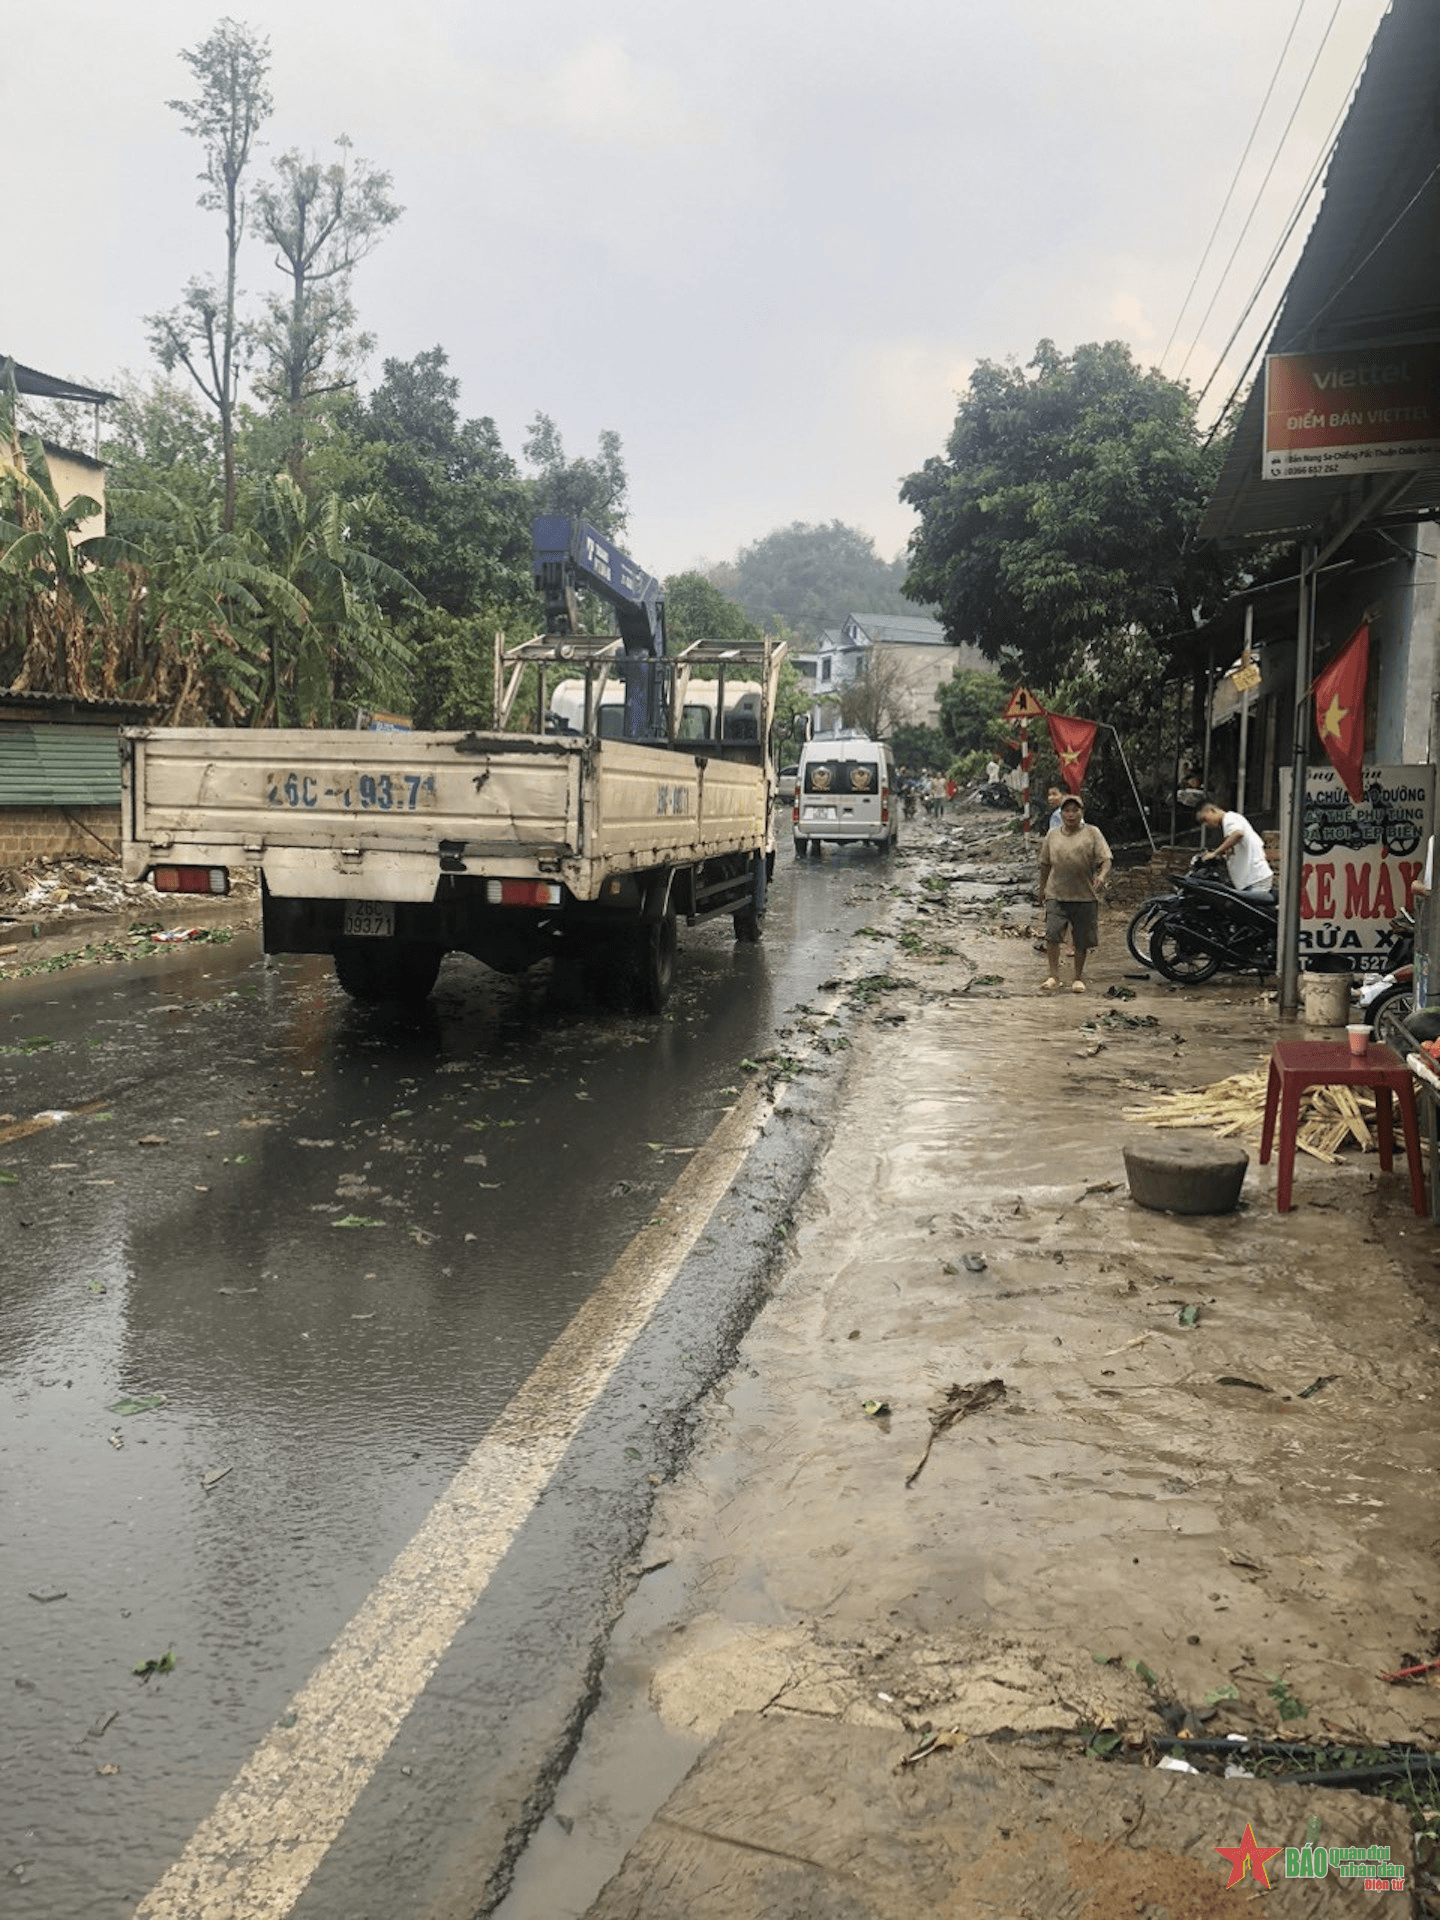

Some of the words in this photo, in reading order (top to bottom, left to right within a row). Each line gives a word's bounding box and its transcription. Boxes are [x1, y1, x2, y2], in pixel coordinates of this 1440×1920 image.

[1287, 408, 1326, 431] ĐIỂM
[1329, 410, 1363, 427] BÁN
[1367, 405, 1430, 424] VIETTEL
[1382, 785, 1425, 802] DƯỠNG
[1388, 806, 1424, 822] TÙNG
[1344, 846, 1423, 919] MÁY
[1298, 923, 1363, 949] RỬA
[1375, 930, 1394, 949] X
